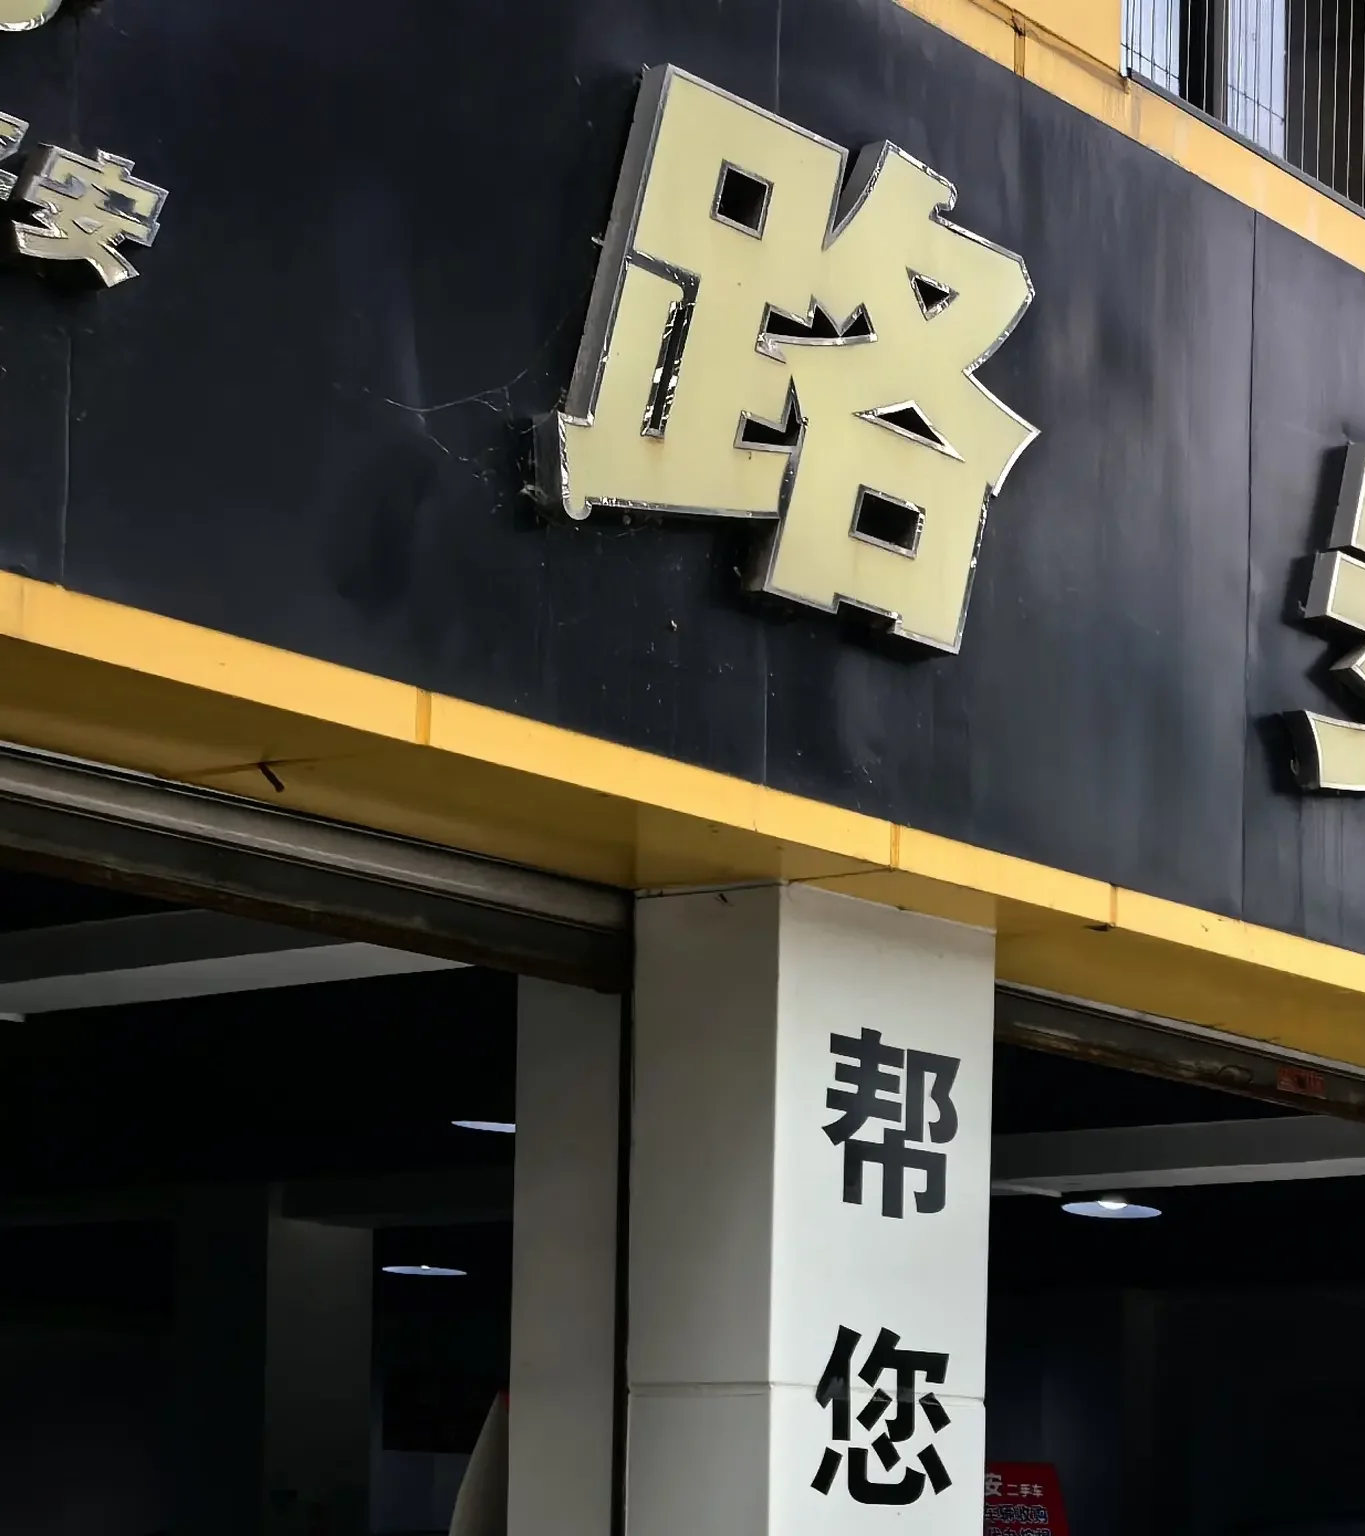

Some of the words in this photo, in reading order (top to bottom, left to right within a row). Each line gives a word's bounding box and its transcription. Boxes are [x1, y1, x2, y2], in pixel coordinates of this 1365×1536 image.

[0, 111, 170, 288] 安
[1007, 1483, 1043, 1498] 二手车
